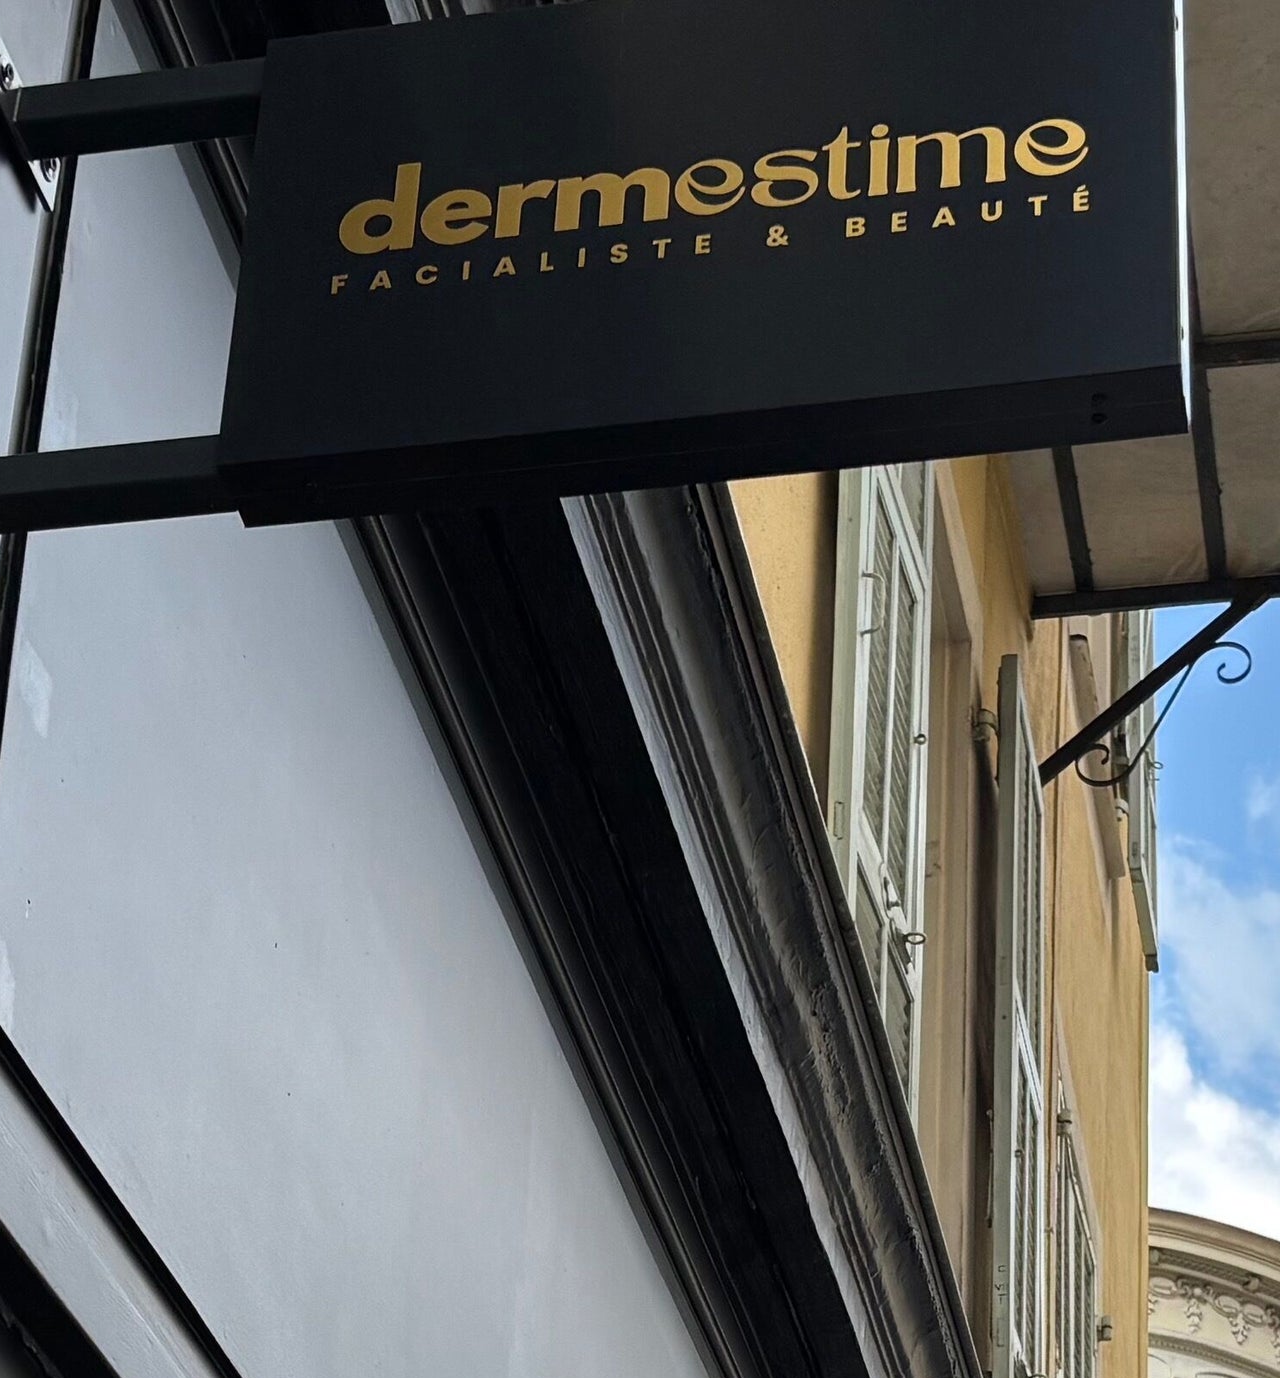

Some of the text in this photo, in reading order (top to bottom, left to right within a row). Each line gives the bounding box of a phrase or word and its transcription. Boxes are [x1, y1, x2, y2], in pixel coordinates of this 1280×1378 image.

[330, 188, 1091, 295] FACIALISTE & BEAUTÉ
[338, 117, 1089, 254] dermestime
